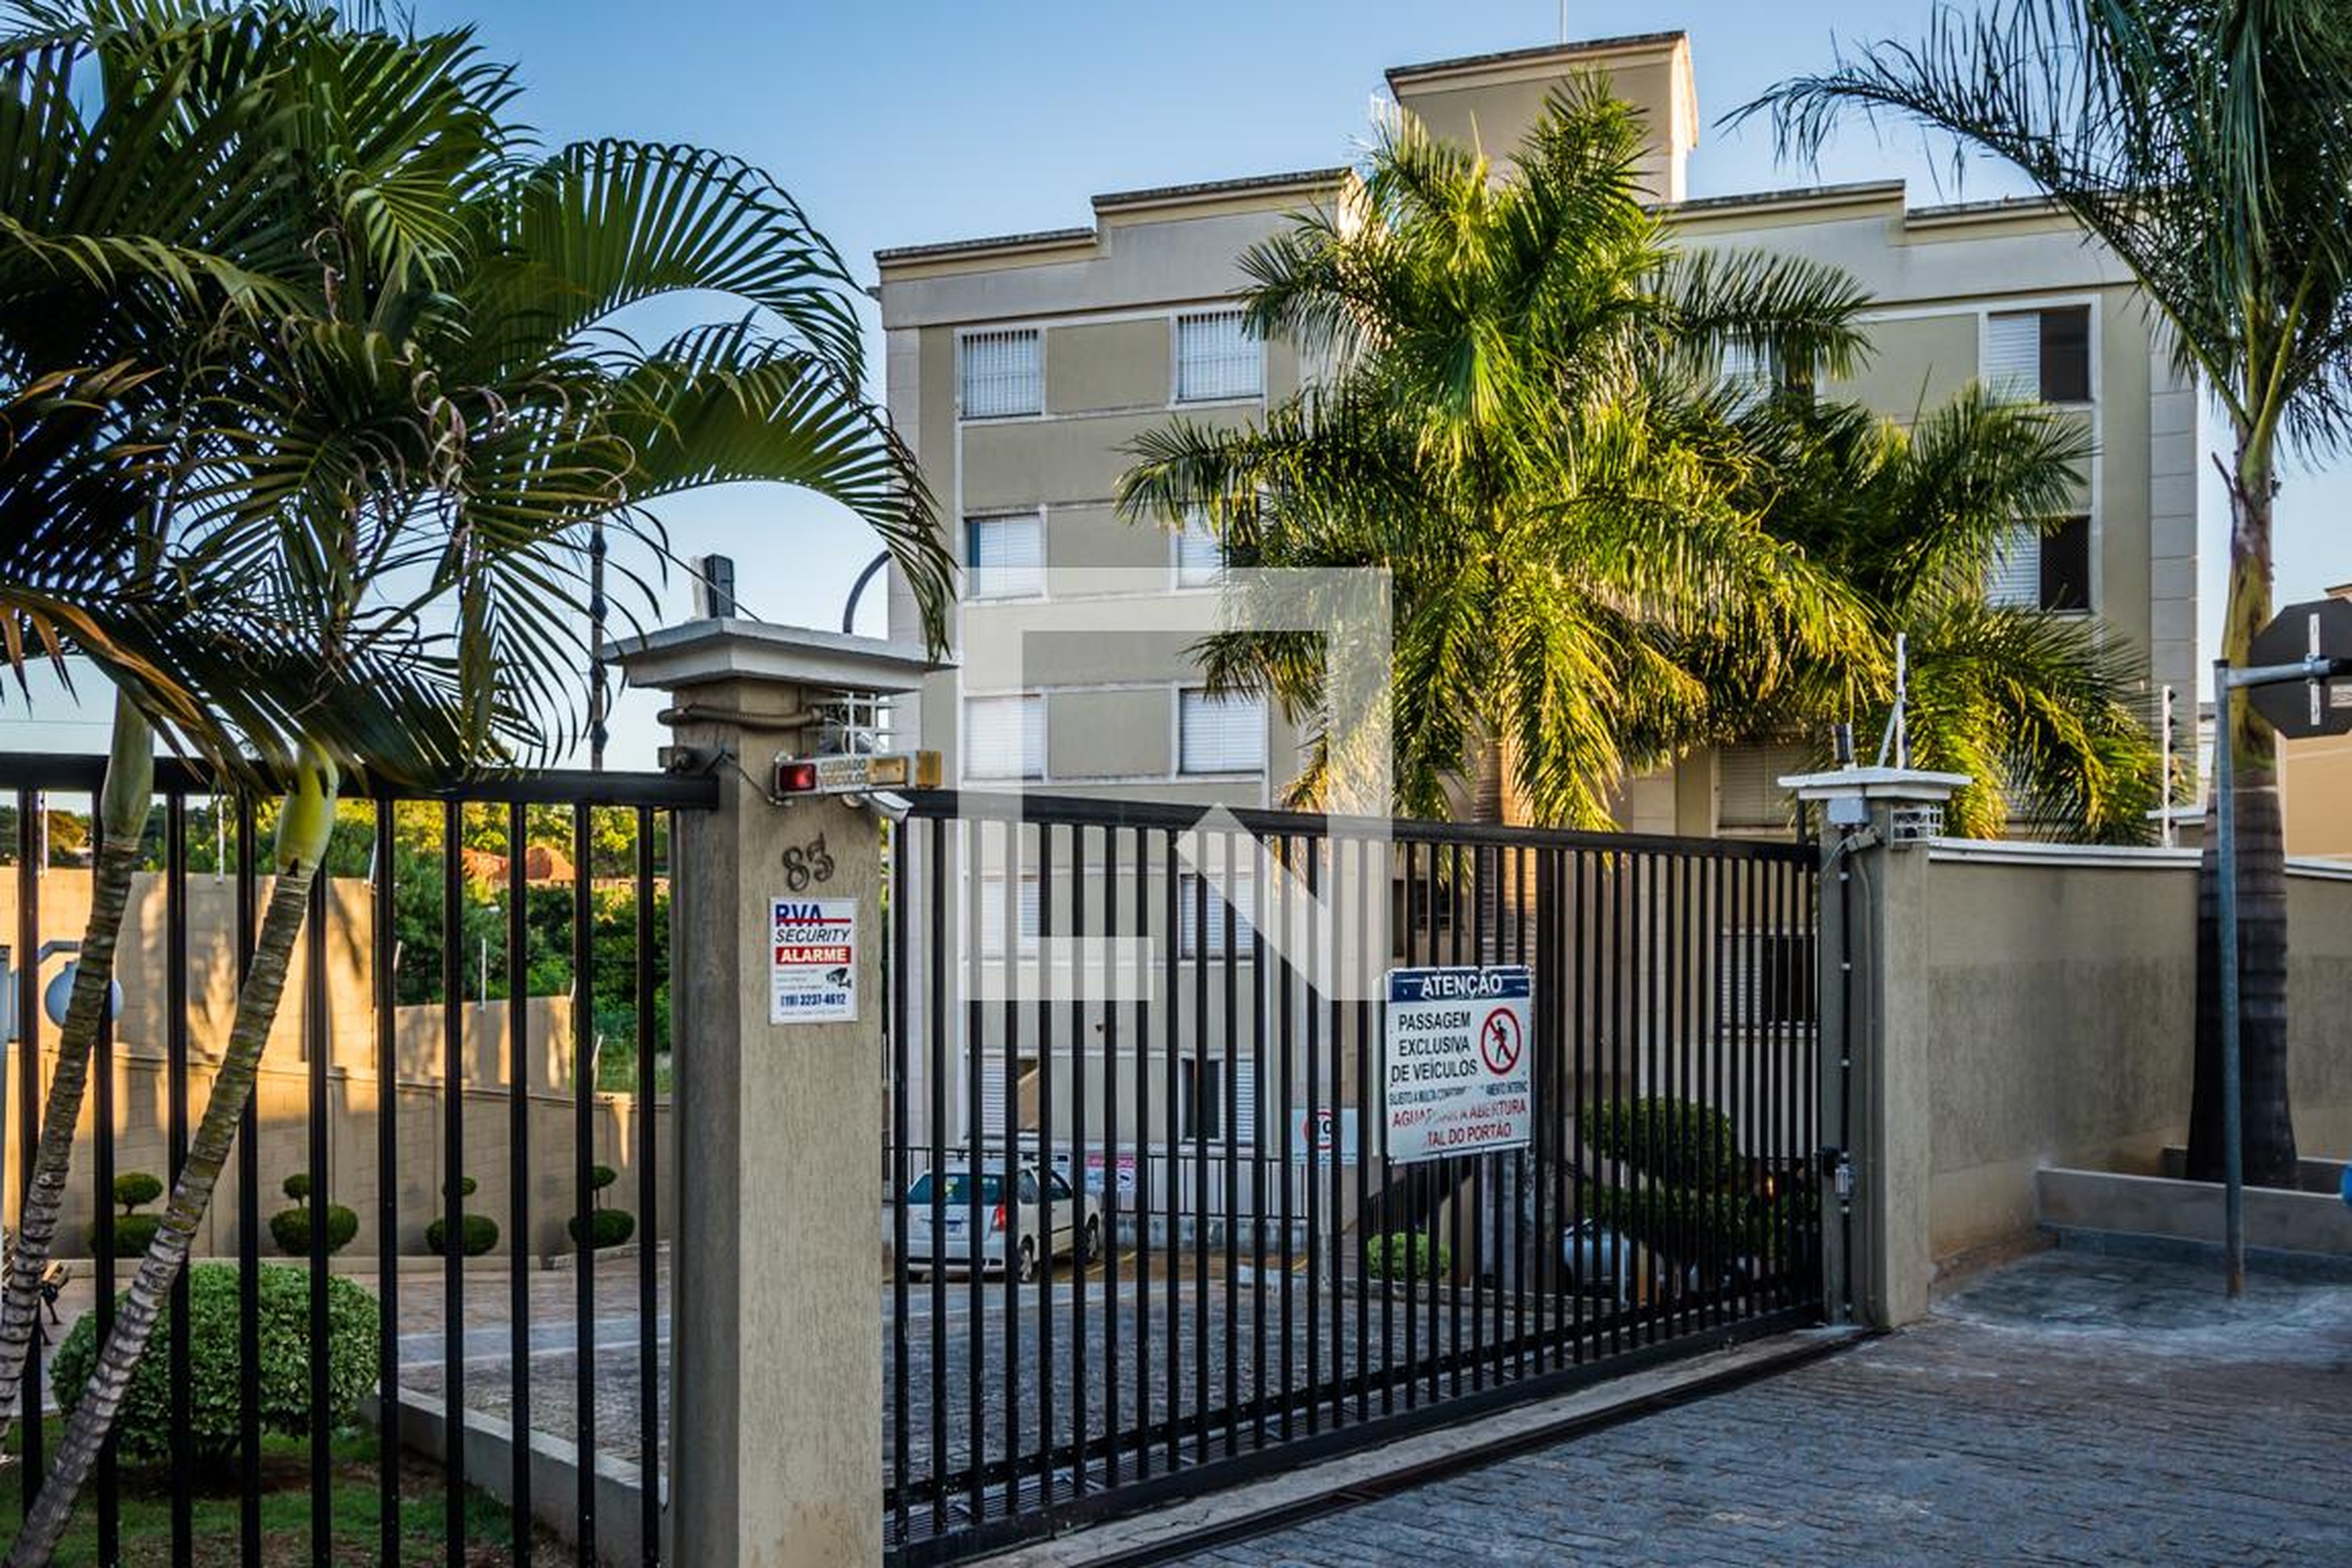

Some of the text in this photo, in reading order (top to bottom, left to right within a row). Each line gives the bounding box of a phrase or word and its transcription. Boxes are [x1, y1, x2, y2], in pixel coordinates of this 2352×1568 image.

[775, 904, 824, 927] RVA
[775, 929, 850, 943] SECURITY
[781, 948, 846, 962] ALARME
[1399, 1012, 1471, 1031] PASSAGEM
[1399, 1036, 1471, 1057] EXCLUSIVA
[1392, 1065, 1409, 1082] DE
[1469, 1099, 1526, 1119] ABERTURA
[1449, 1128, 1464, 1144] DO
